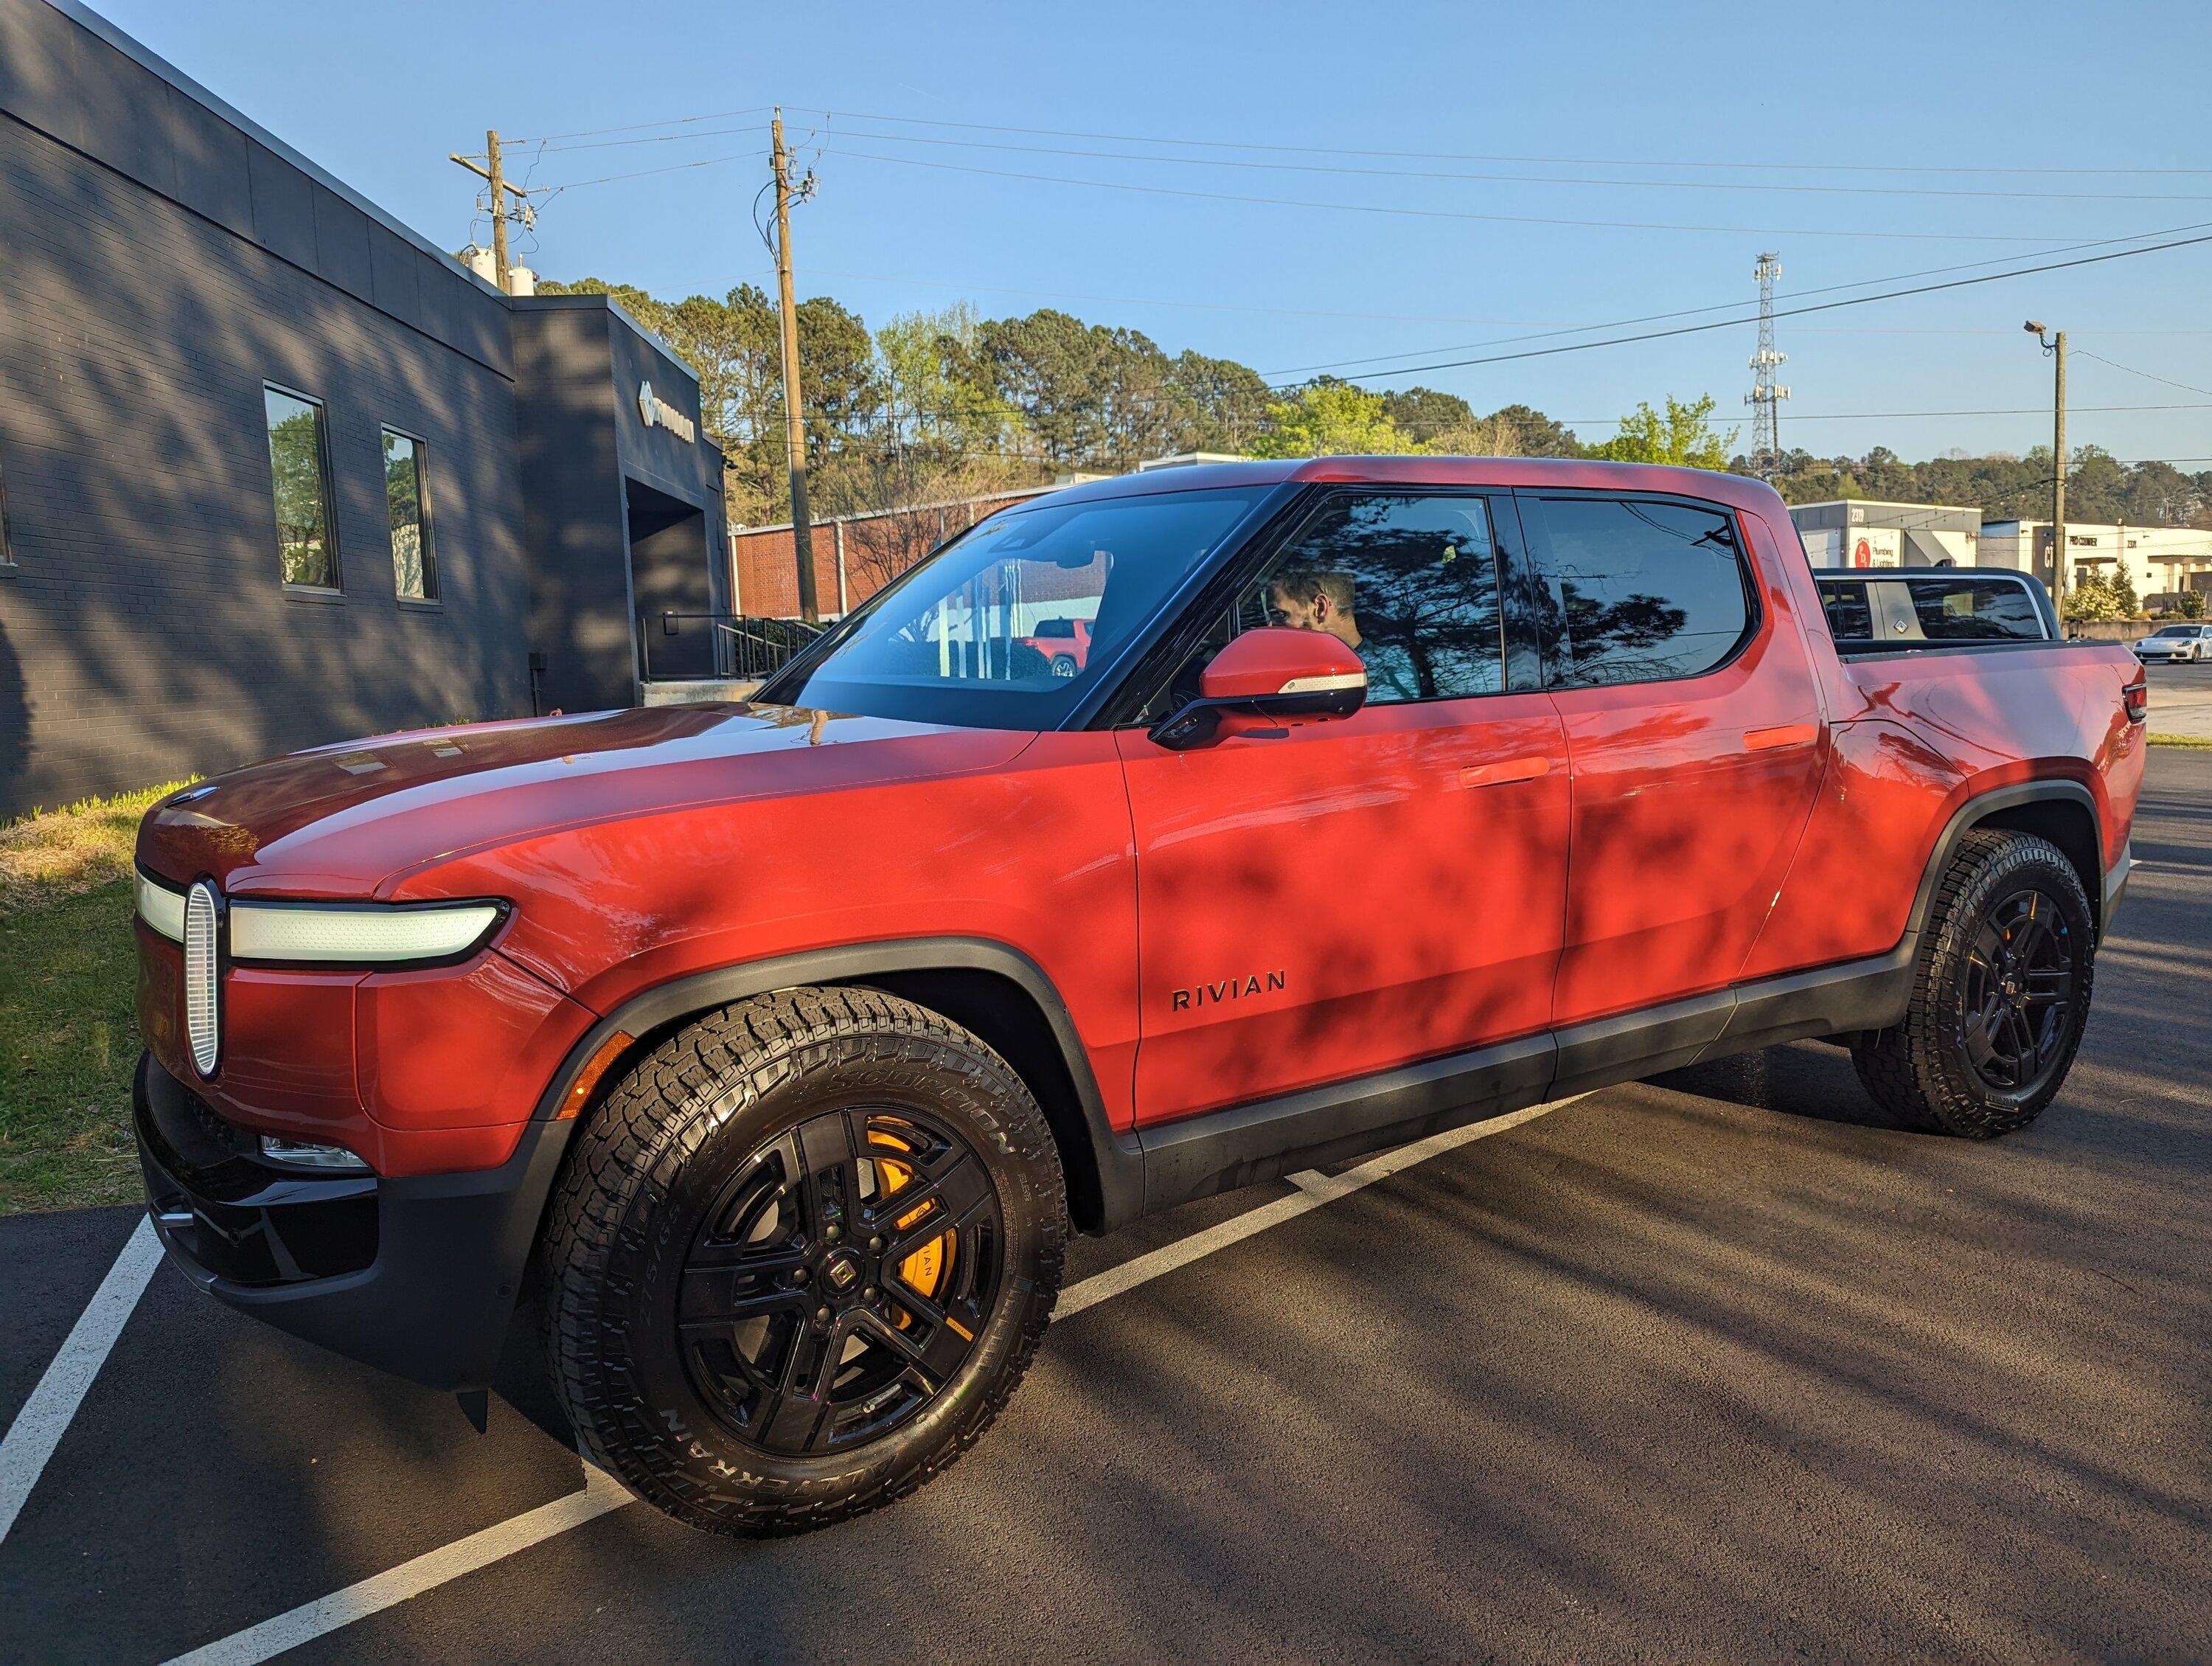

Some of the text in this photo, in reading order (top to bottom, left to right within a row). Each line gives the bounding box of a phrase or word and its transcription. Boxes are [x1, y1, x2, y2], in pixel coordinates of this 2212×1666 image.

[1873, 547, 1893, 557] Plumbing
[1171, 969, 1285, 1012] RIVIAN
[827, 1069, 1017, 1155] SCORPION
